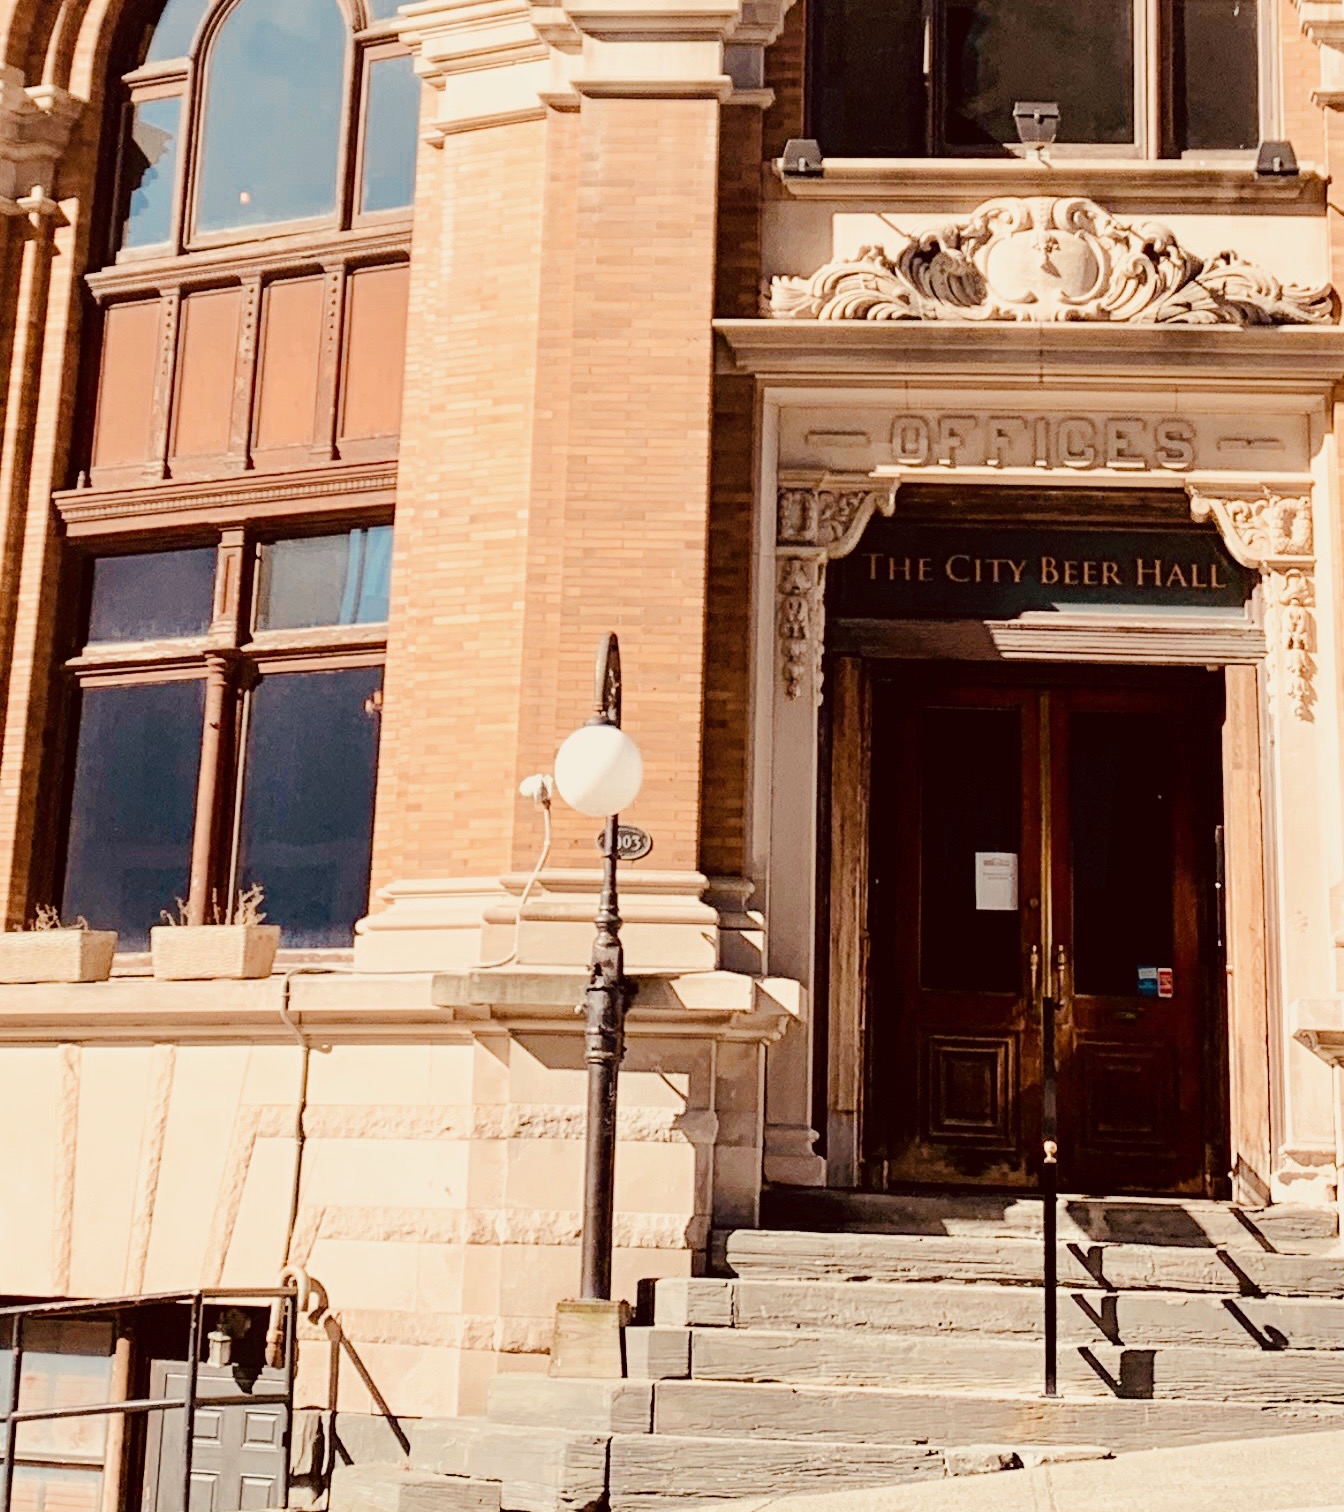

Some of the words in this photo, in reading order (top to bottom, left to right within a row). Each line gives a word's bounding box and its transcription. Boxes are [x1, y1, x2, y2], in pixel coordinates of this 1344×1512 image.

[890, 415, 1197, 470] OFFICES
[863, 553, 933, 581] THE
[946, 555, 1027, 584] CITY
[1040, 556, 1122, 586] BEER
[1136, 558, 1228, 589] HALL
